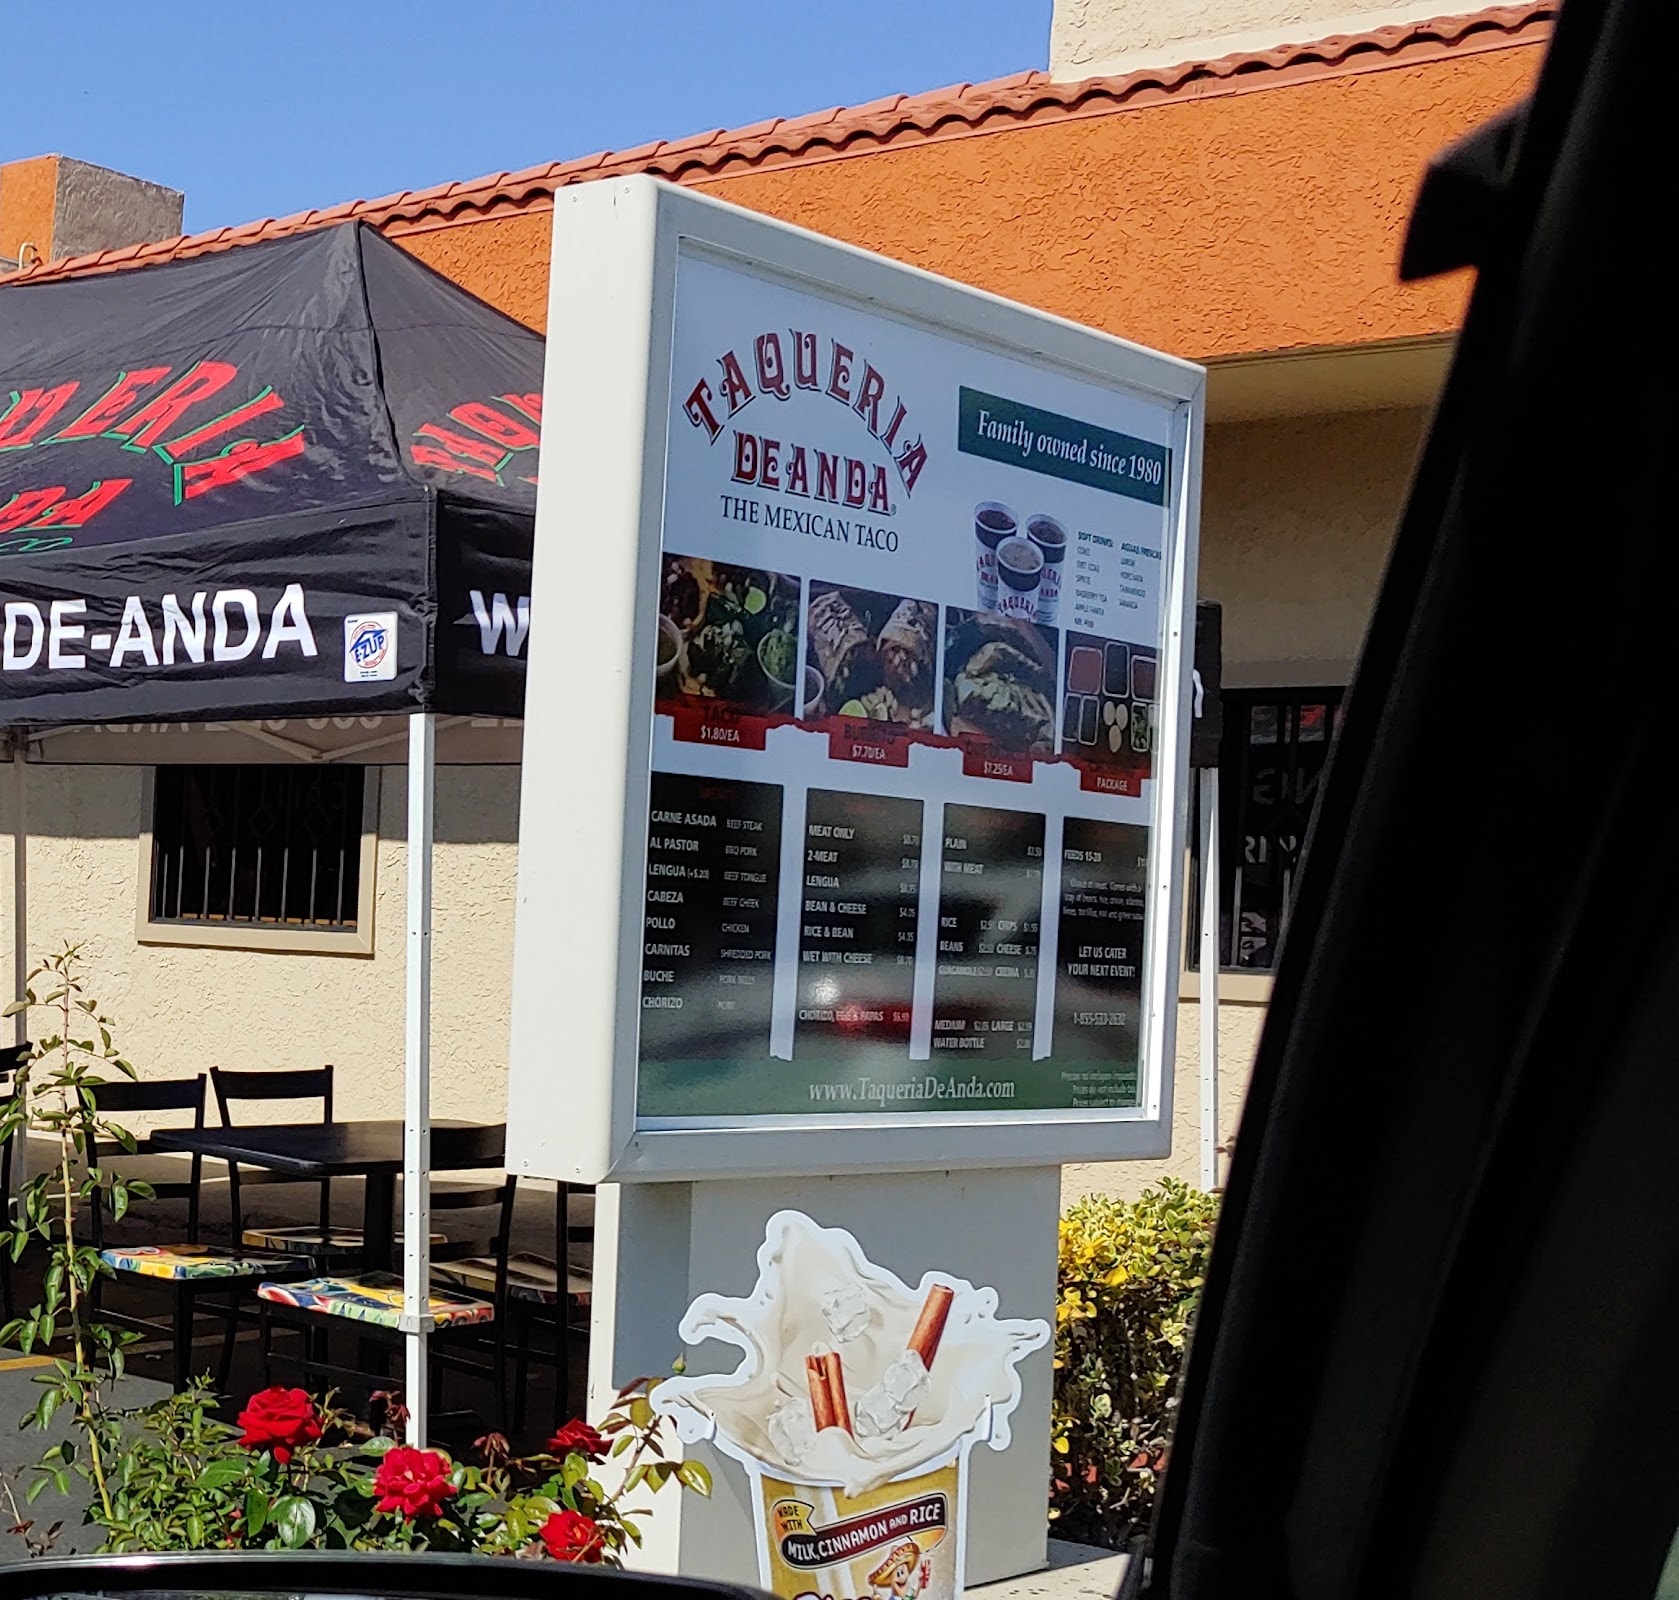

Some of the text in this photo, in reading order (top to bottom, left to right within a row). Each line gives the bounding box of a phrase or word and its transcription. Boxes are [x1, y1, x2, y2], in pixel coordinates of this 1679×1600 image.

[682, 328, 928, 499] TAQUERIA
[977, 409, 1161, 485] Family owned since 1980
[731, 430, 892, 516] DEANDA
[720, 495, 898, 552] THE MEXICAN TACO
[470, 590, 530, 657] W
[1096, 777, 1128, 792] PACKAGE
[651, 811, 682, 824] CARNE
[684, 813, 717, 827] ASADA
[808, 825, 832, 837] MEAT
[833, 827, 855, 839] ONLY
[650, 837, 662, 849] AL
[664, 839, 699, 851] PASTOR
[945, 838, 967, 850] PLAIN
[807, 850, 838, 862] 2-MEAT
[648, 863, 685, 877] LENGUA
[806, 875, 839, 888] LENGUA
[647, 890, 684, 903] CABEZA
[805, 900, 828, 912] BEAN
[838, 902, 867, 914] CHEESE
[645, 917, 750, 933] POLLO CHICKEN
[804, 926, 822, 937] RICE
[832, 927, 854, 938] BEAN
[645, 943, 691, 957] CARNITAS
[940, 940, 964, 952] BEANS
[1079, 945, 1127, 959] LET US CATER
[802, 951, 820, 962] WET
[843, 953, 873, 964] CHEESE
[643, 970, 675, 982] BUCHE
[1068, 963, 1089, 976] YOUR
[1090, 963, 1109, 976] NEXT
[642, 996, 683, 1009] CHORIZO
[934, 1019, 966, 1030] MEDIUM
[933, 1037, 958, 1049] WATER
[959, 1037, 985, 1049] BOTTLE
[809, 1076, 1015, 1108] www.TaqueriaDeAnda.com
[777, 1505, 799, 1517] MADE
[781, 1519, 803, 1532] WITH
[787, 1503, 941, 1562] MILK, CINNAMON AND RICE
